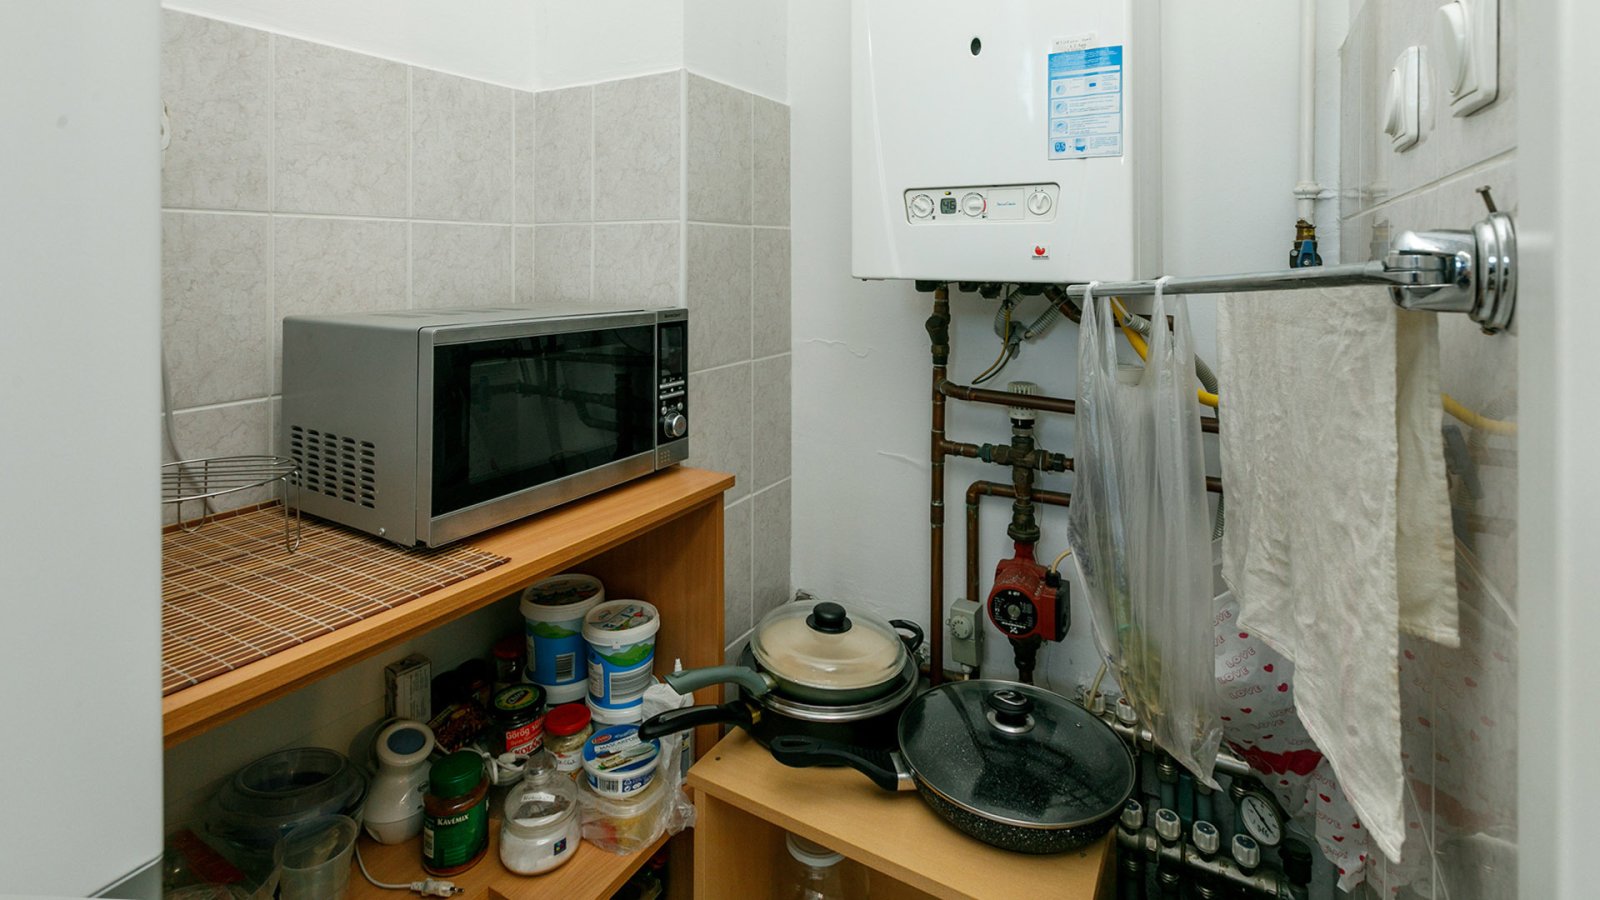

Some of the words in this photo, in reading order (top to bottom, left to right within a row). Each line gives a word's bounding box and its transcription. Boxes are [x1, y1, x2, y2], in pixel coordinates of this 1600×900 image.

[1226, 647, 1256, 668] LOVE
[1217, 665, 1250, 684] LOVE
[1230, 684, 1263, 699] LOVE
[506, 728, 530, 740] Görög
